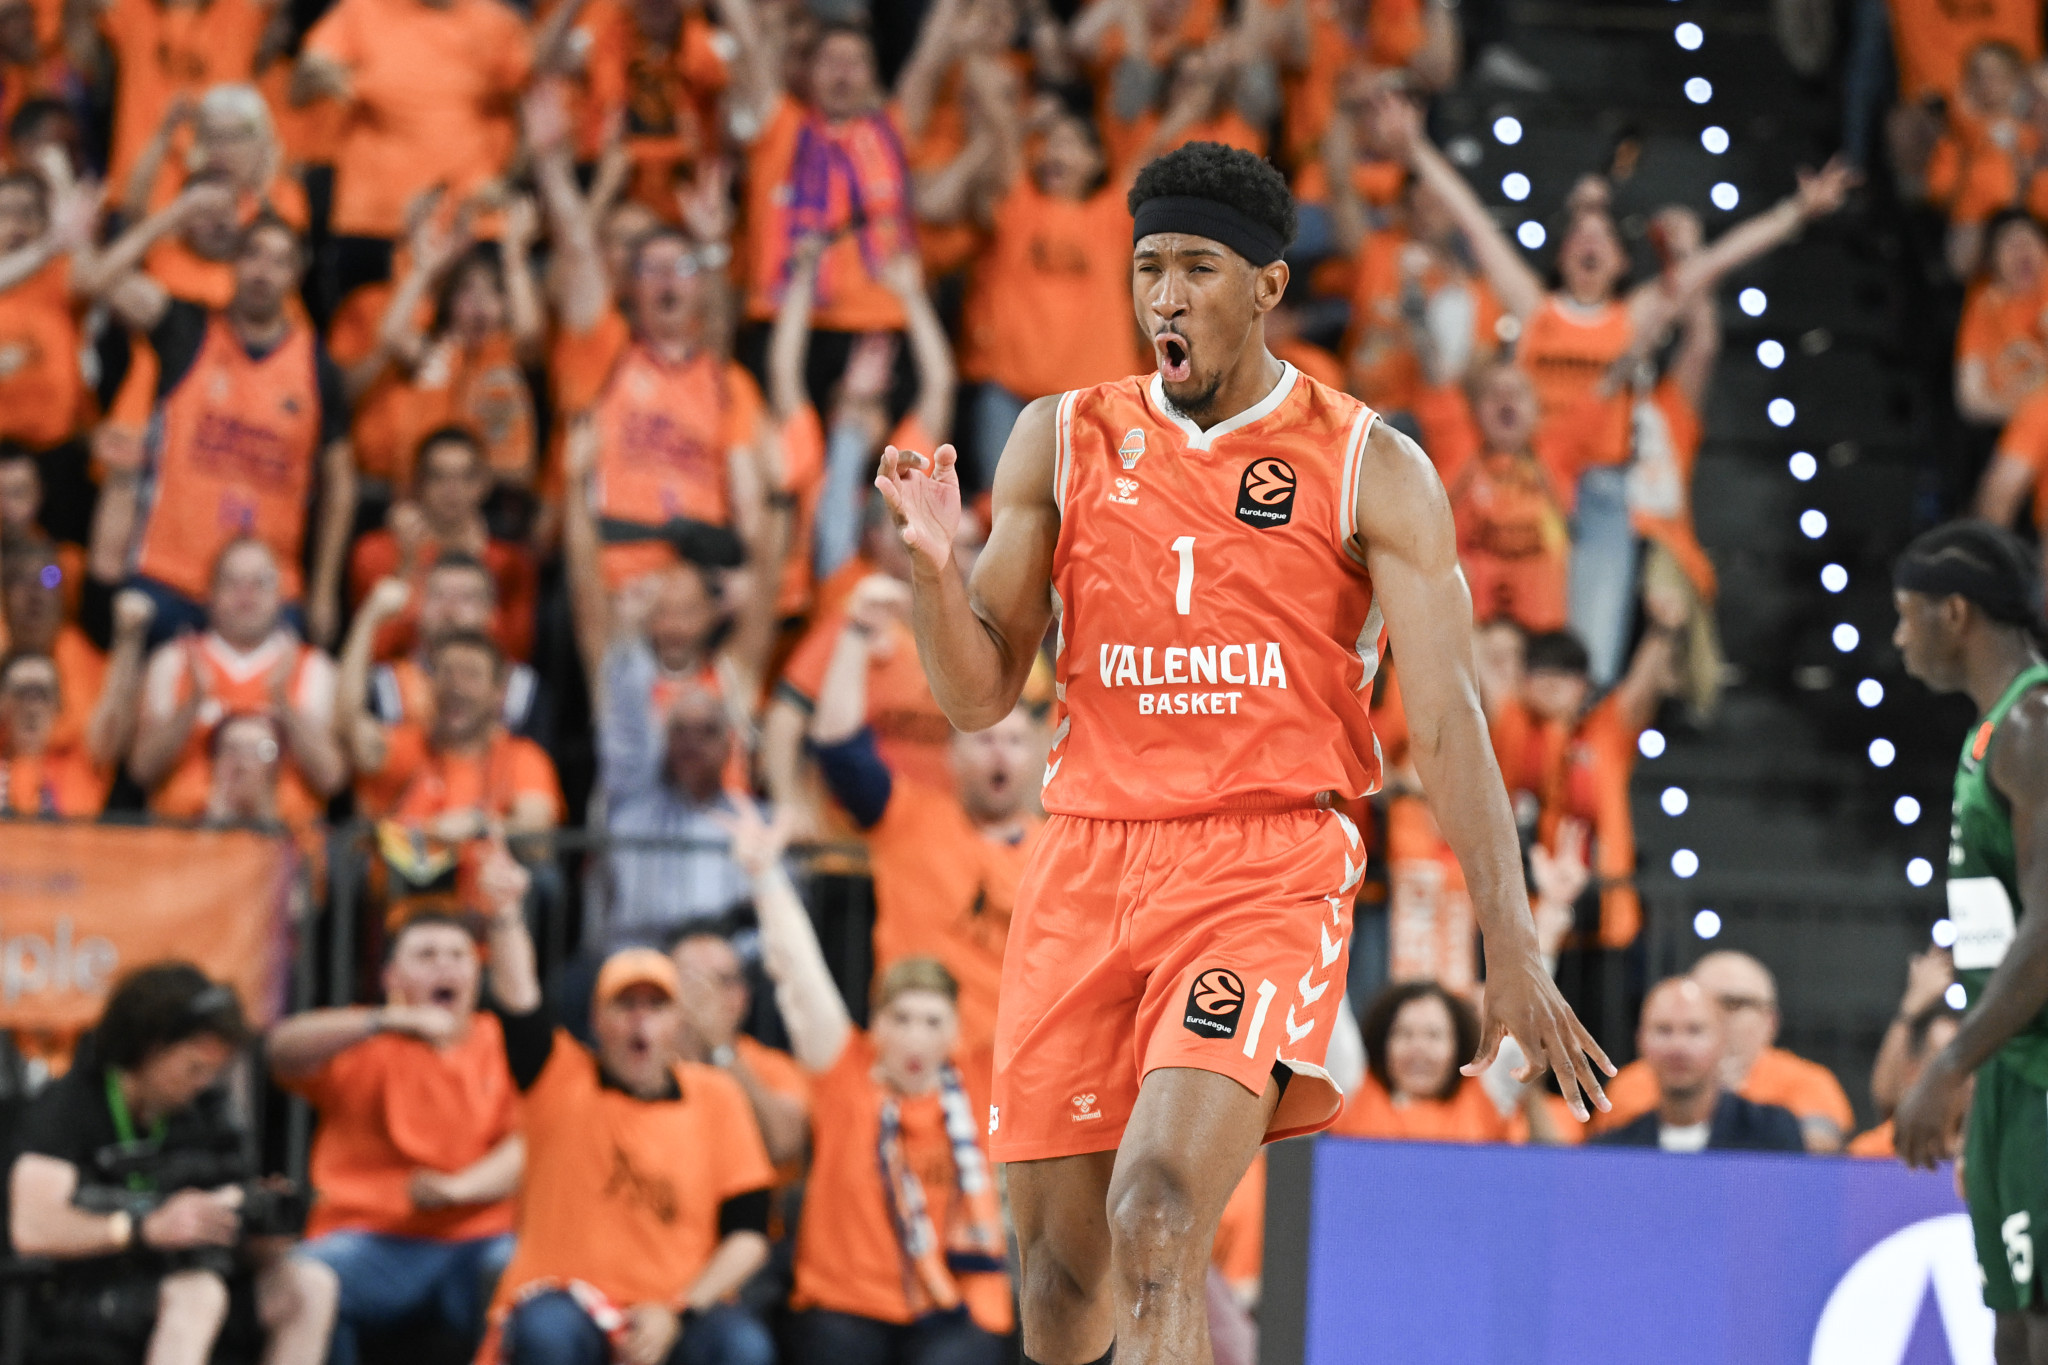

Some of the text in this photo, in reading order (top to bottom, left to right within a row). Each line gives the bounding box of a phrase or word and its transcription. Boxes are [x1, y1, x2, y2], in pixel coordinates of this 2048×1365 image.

[1239, 507, 1288, 520] EuroLeague
[1171, 535, 1197, 615] 1
[1099, 642, 1287, 689] VALENCIA
[1138, 691, 1243, 715] BASKET
[1186, 1015, 1232, 1034] EuroLeague
[1242, 978, 1278, 1060] 1
[1072, 1109, 1102, 1122] hummel
